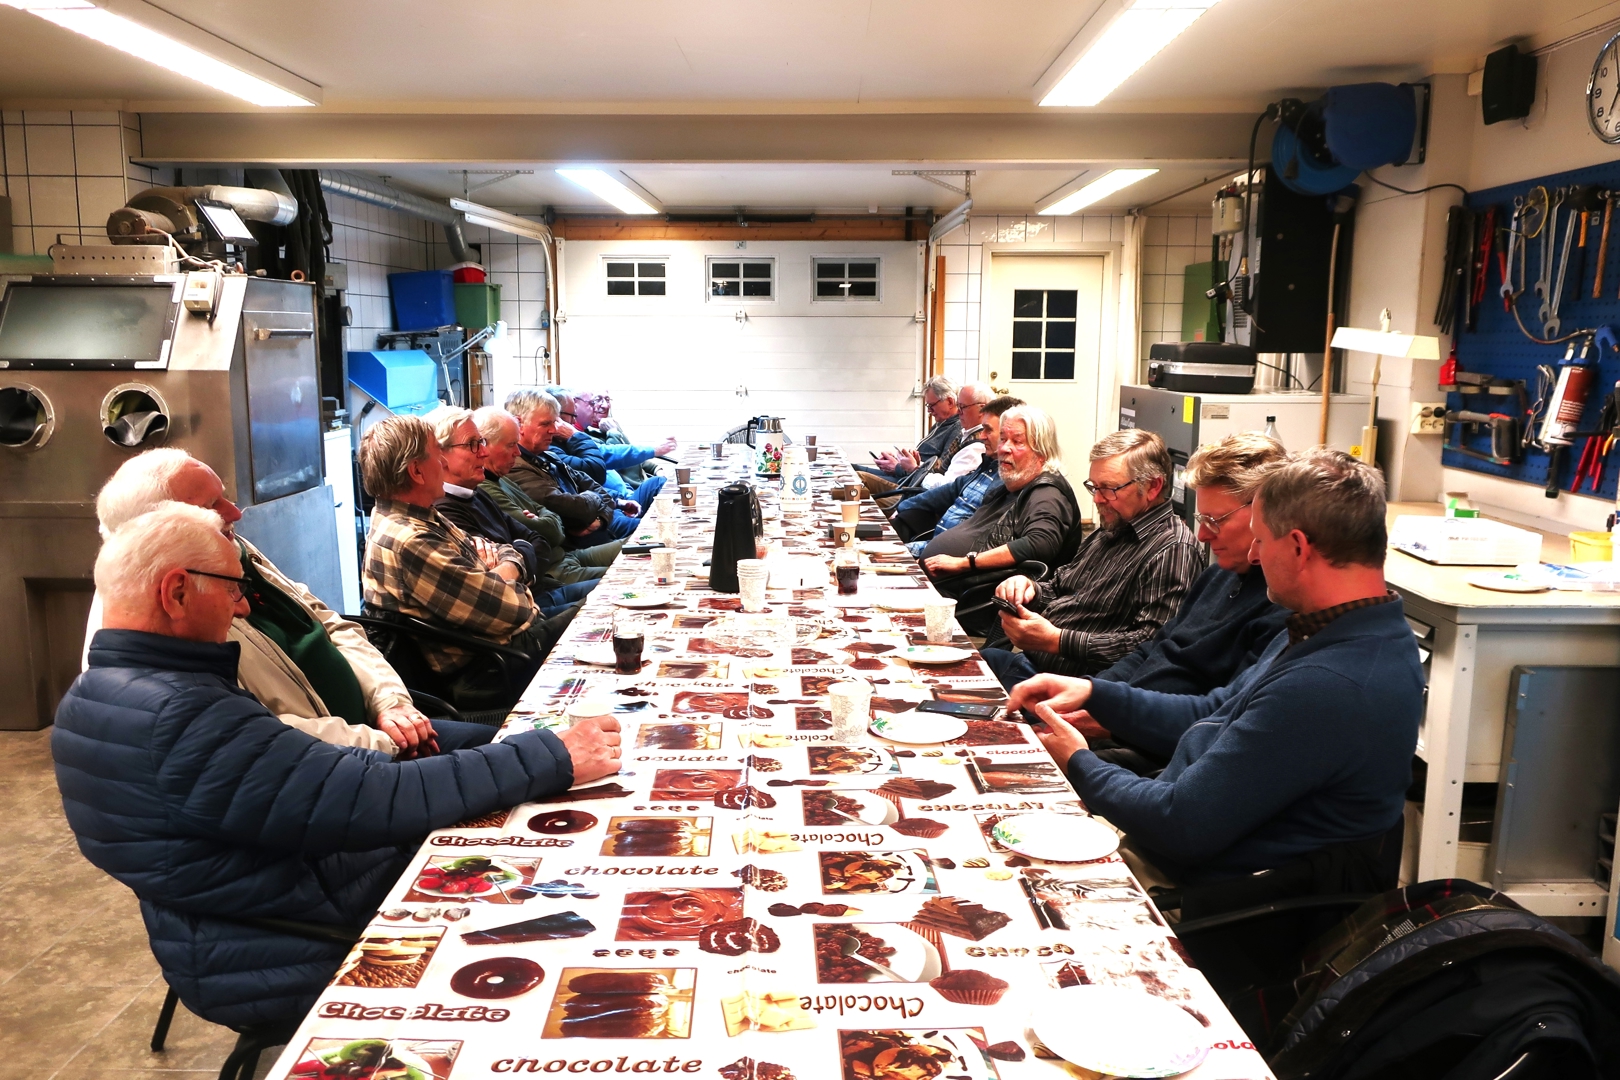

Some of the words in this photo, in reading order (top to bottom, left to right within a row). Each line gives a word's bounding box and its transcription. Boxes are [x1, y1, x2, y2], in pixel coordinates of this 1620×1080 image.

[1600, 67, 1608, 78] 10
[1594, 88, 1602, 99] 9
[1597, 107, 1604, 118] 8
[1604, 119, 1610, 131] 7
[430, 835, 575, 848] Chocolate
[790, 832, 884, 847] Chocolate
[564, 865, 719, 876] chocolate
[318, 1001, 511, 1023] Chocolate
[799, 994, 925, 1019] Chocolate
